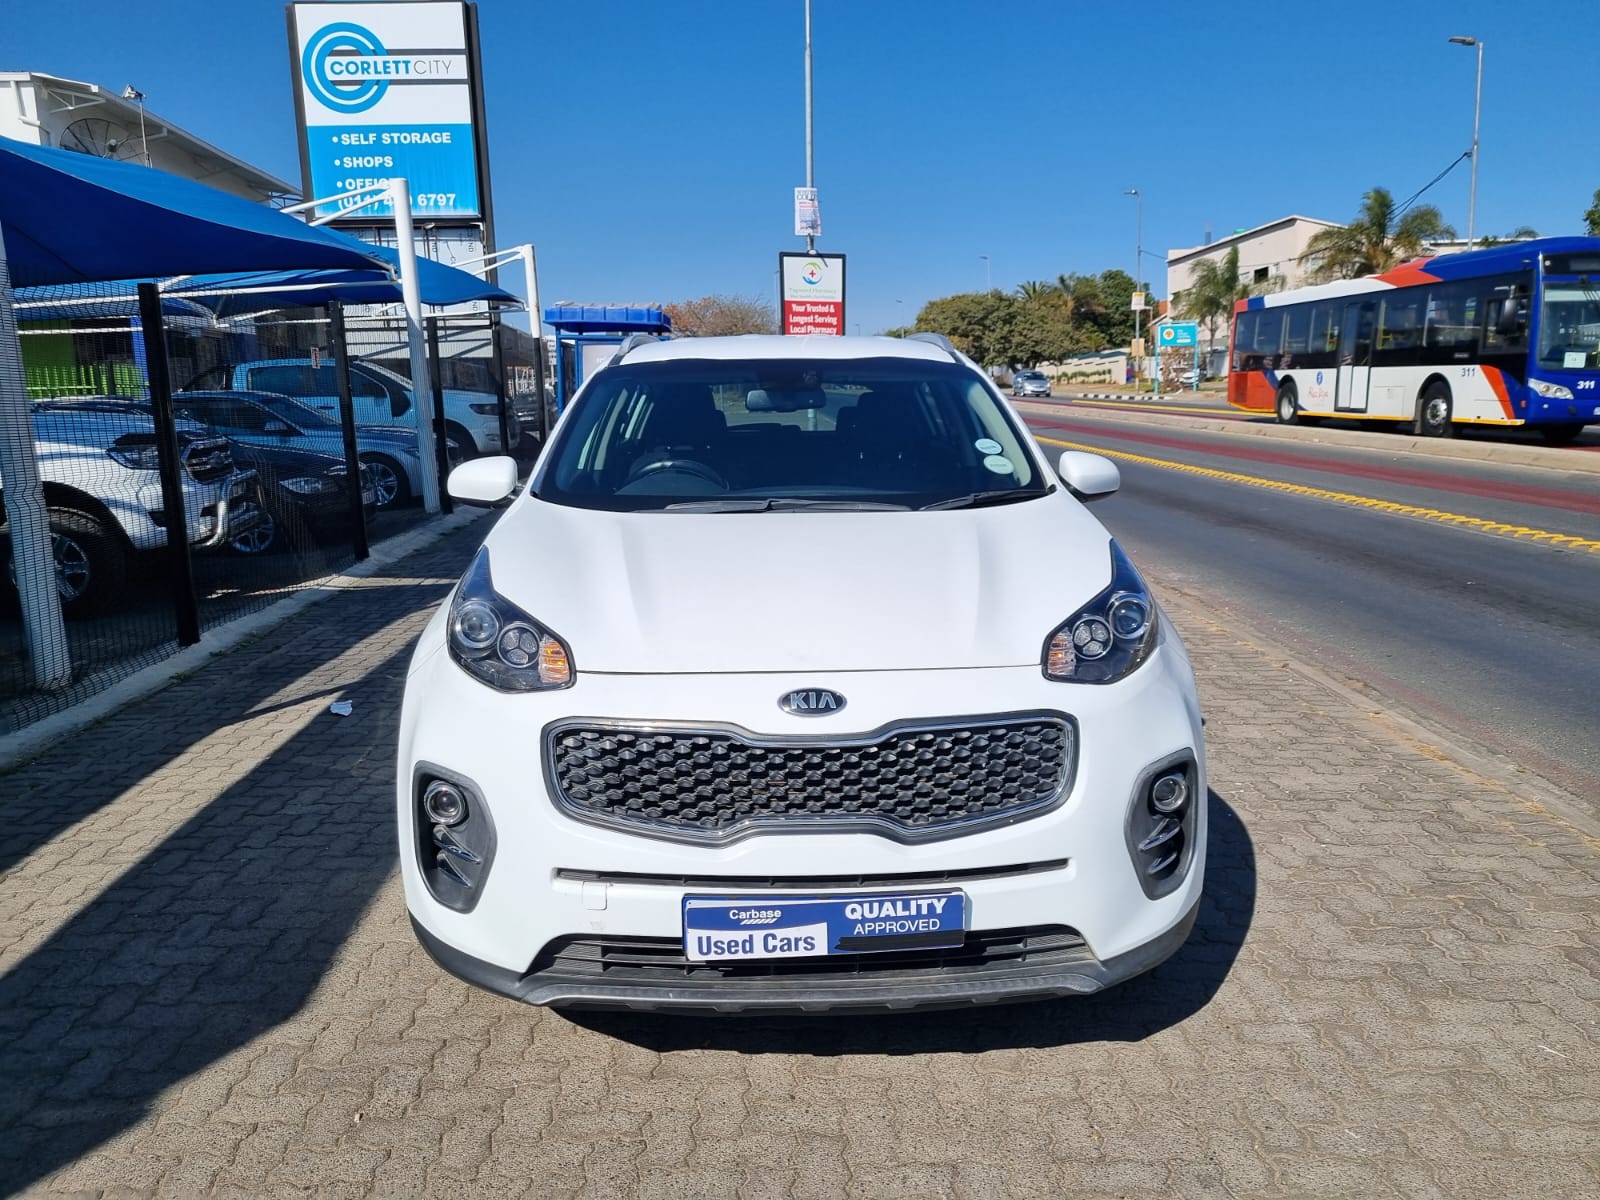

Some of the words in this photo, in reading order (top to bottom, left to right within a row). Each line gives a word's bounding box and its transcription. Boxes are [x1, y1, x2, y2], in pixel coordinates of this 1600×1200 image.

[330, 60, 411, 76] CORLETT
[413, 59, 453, 76] CITY
[341, 133, 377, 146] SELF
[382, 132, 452, 145] STORAGE
[343, 156, 394, 168] SHOPS
[417, 193, 456, 207] 6797
[791, 303, 806, 312] Your
[806, 303, 829, 313] Trusted
[790, 314, 814, 324] Longest
[814, 315, 838, 325] Serving
[790, 325, 806, 333] Local
[807, 326, 838, 336] Pharmacy
[1461, 367, 1475, 377] 311
[1577, 381, 1596, 390] 311
[790, 692, 837, 709] KIA
[729, 909, 782, 920] Carbase
[845, 897, 948, 920] QUALITY
[853, 918, 941, 935] APPROVED
[697, 934, 755, 956] Used
[762, 933, 816, 954] Cars
